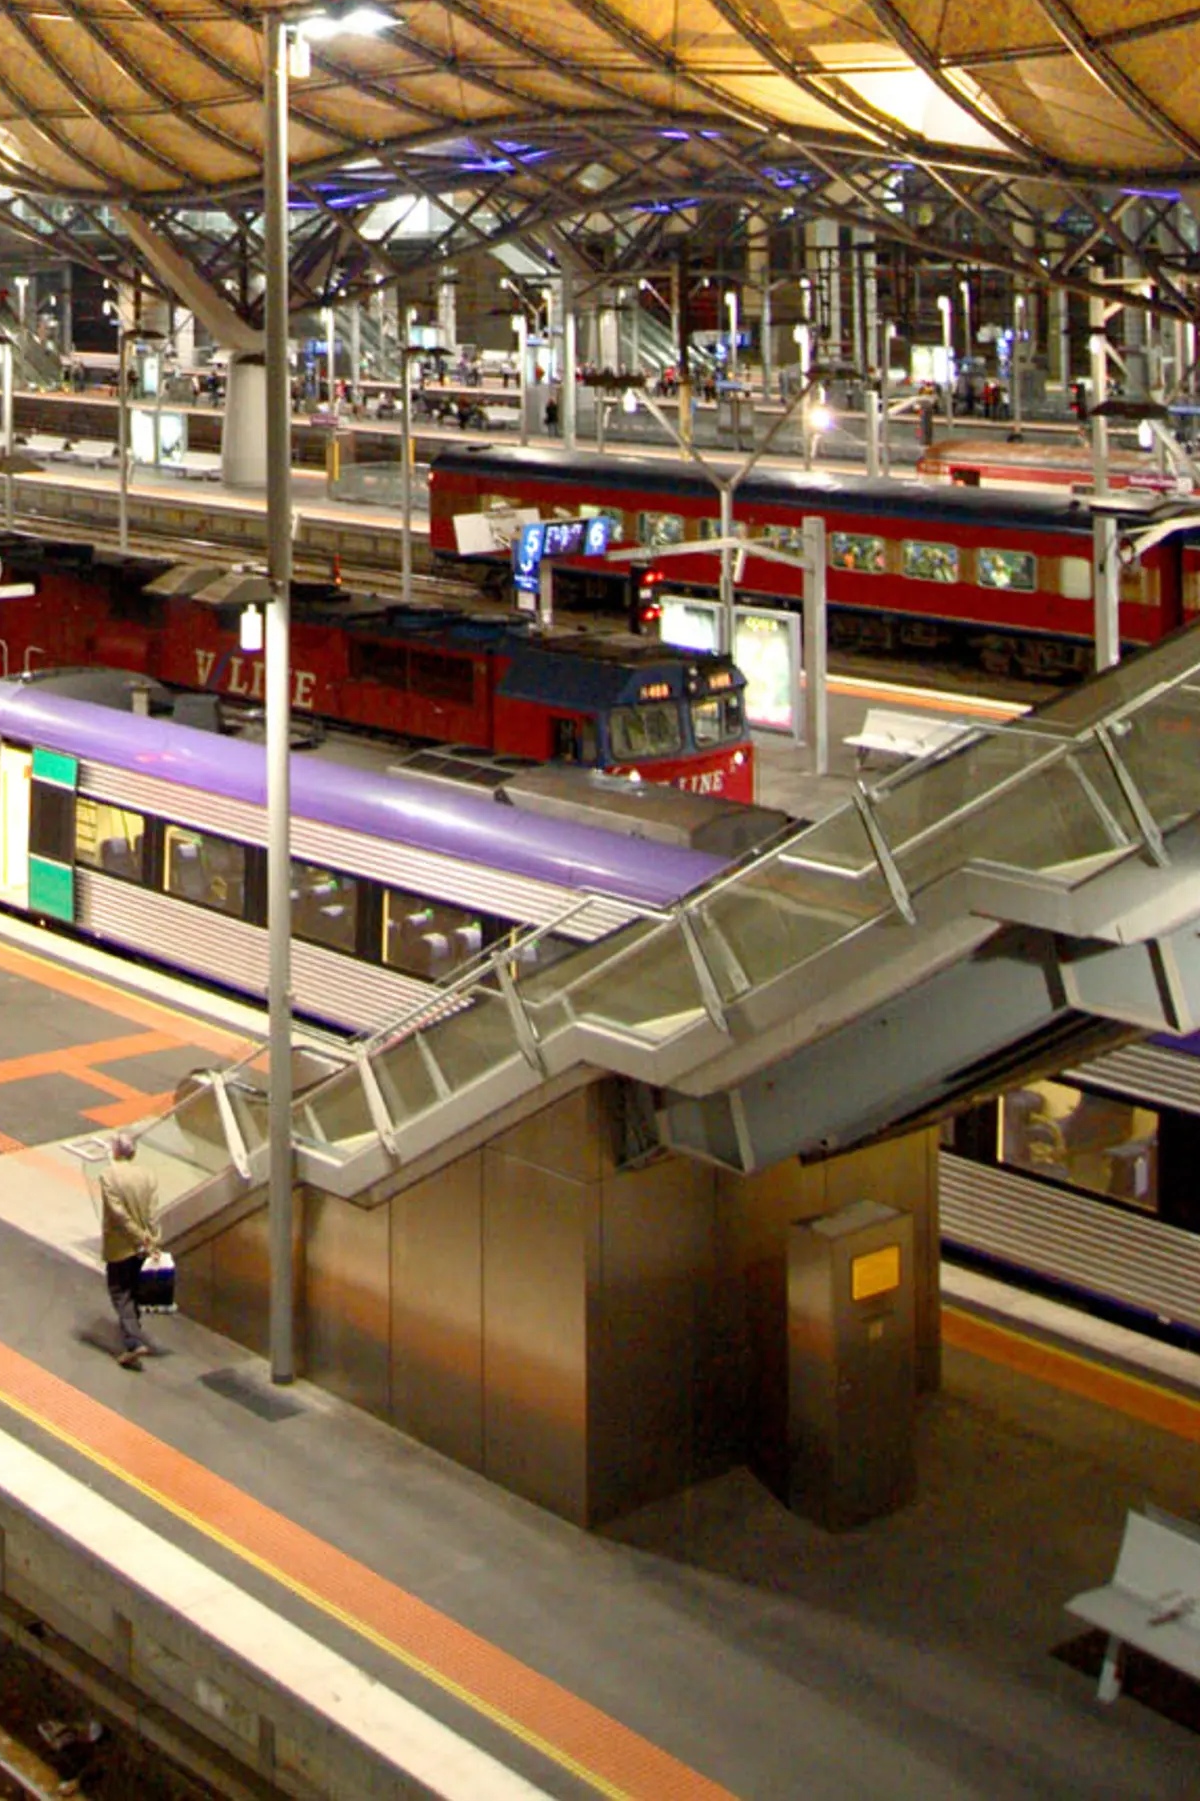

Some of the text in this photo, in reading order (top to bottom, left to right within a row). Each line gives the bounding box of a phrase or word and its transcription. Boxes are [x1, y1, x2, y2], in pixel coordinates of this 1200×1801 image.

[525, 530, 540, 553] 5
[589, 522, 605, 546] 6
[194, 646, 317, 708] V/LIE
